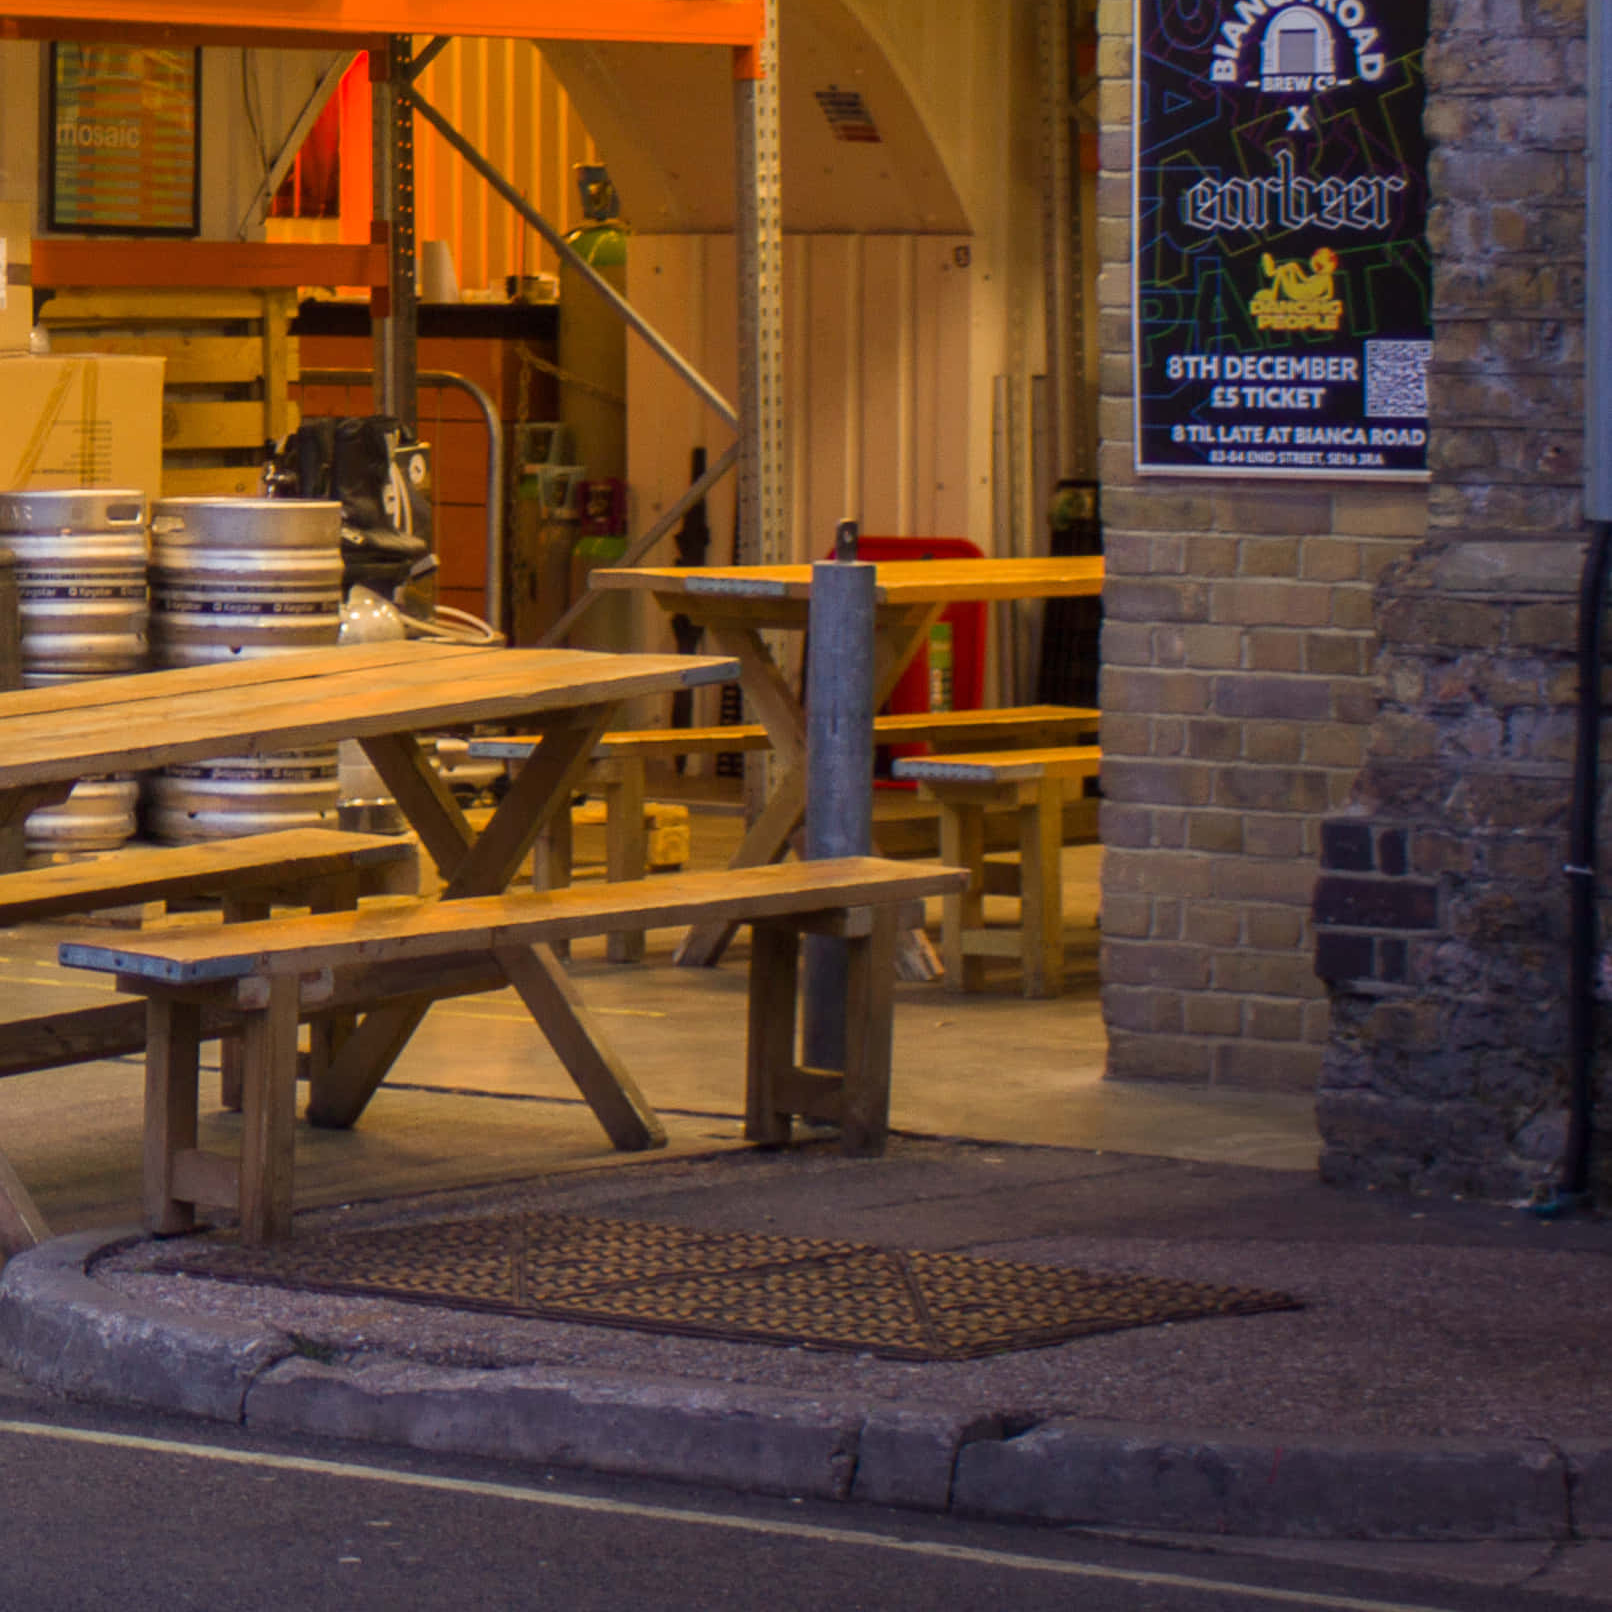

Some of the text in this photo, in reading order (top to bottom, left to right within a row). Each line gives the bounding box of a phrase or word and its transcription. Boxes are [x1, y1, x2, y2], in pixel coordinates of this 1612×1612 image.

[1260, 75, 1313, 92] BREW
[1286, 105, 1311, 131] X
[56, 120, 141, 149] mosaic
[1183, 148, 1408, 230] earbeer
[1249, 299, 1343, 317] DANCING
[1257, 314, 1340, 331] PEOPLE
[1165, 355, 1360, 382] 8TH DECEMBER
[1210, 386, 1327, 409] £5 TICKET
[1170, 424, 1427, 447] 8 TIL LATE AT BIANCA ROAD
